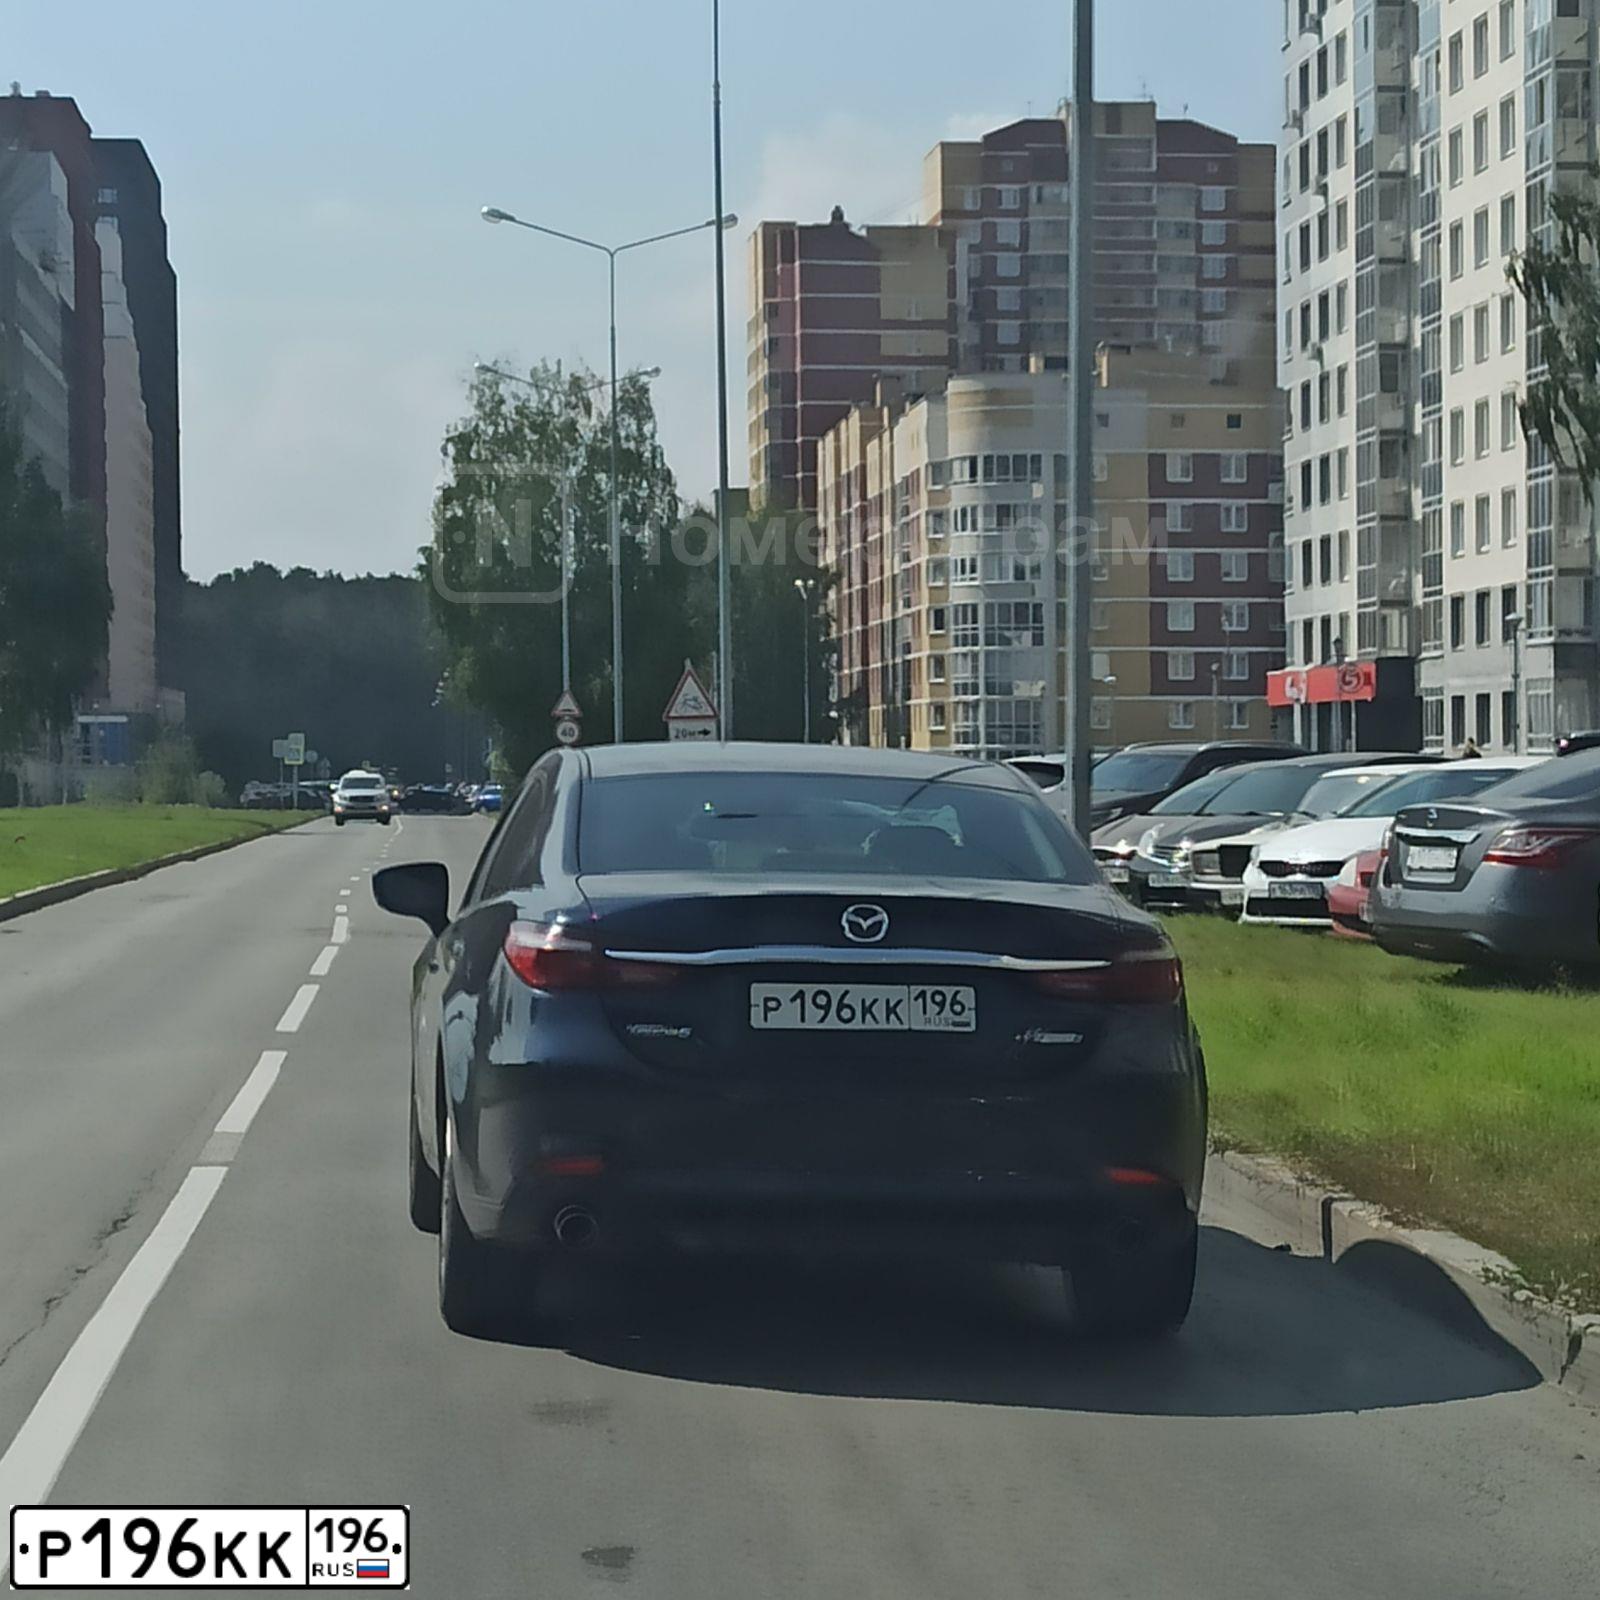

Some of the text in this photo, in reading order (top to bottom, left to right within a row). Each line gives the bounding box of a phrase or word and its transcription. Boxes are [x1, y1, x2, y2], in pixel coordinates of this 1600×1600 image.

[560, 727, 575, 738] 40
[762, 988, 966, 1025] Р196КК 196
